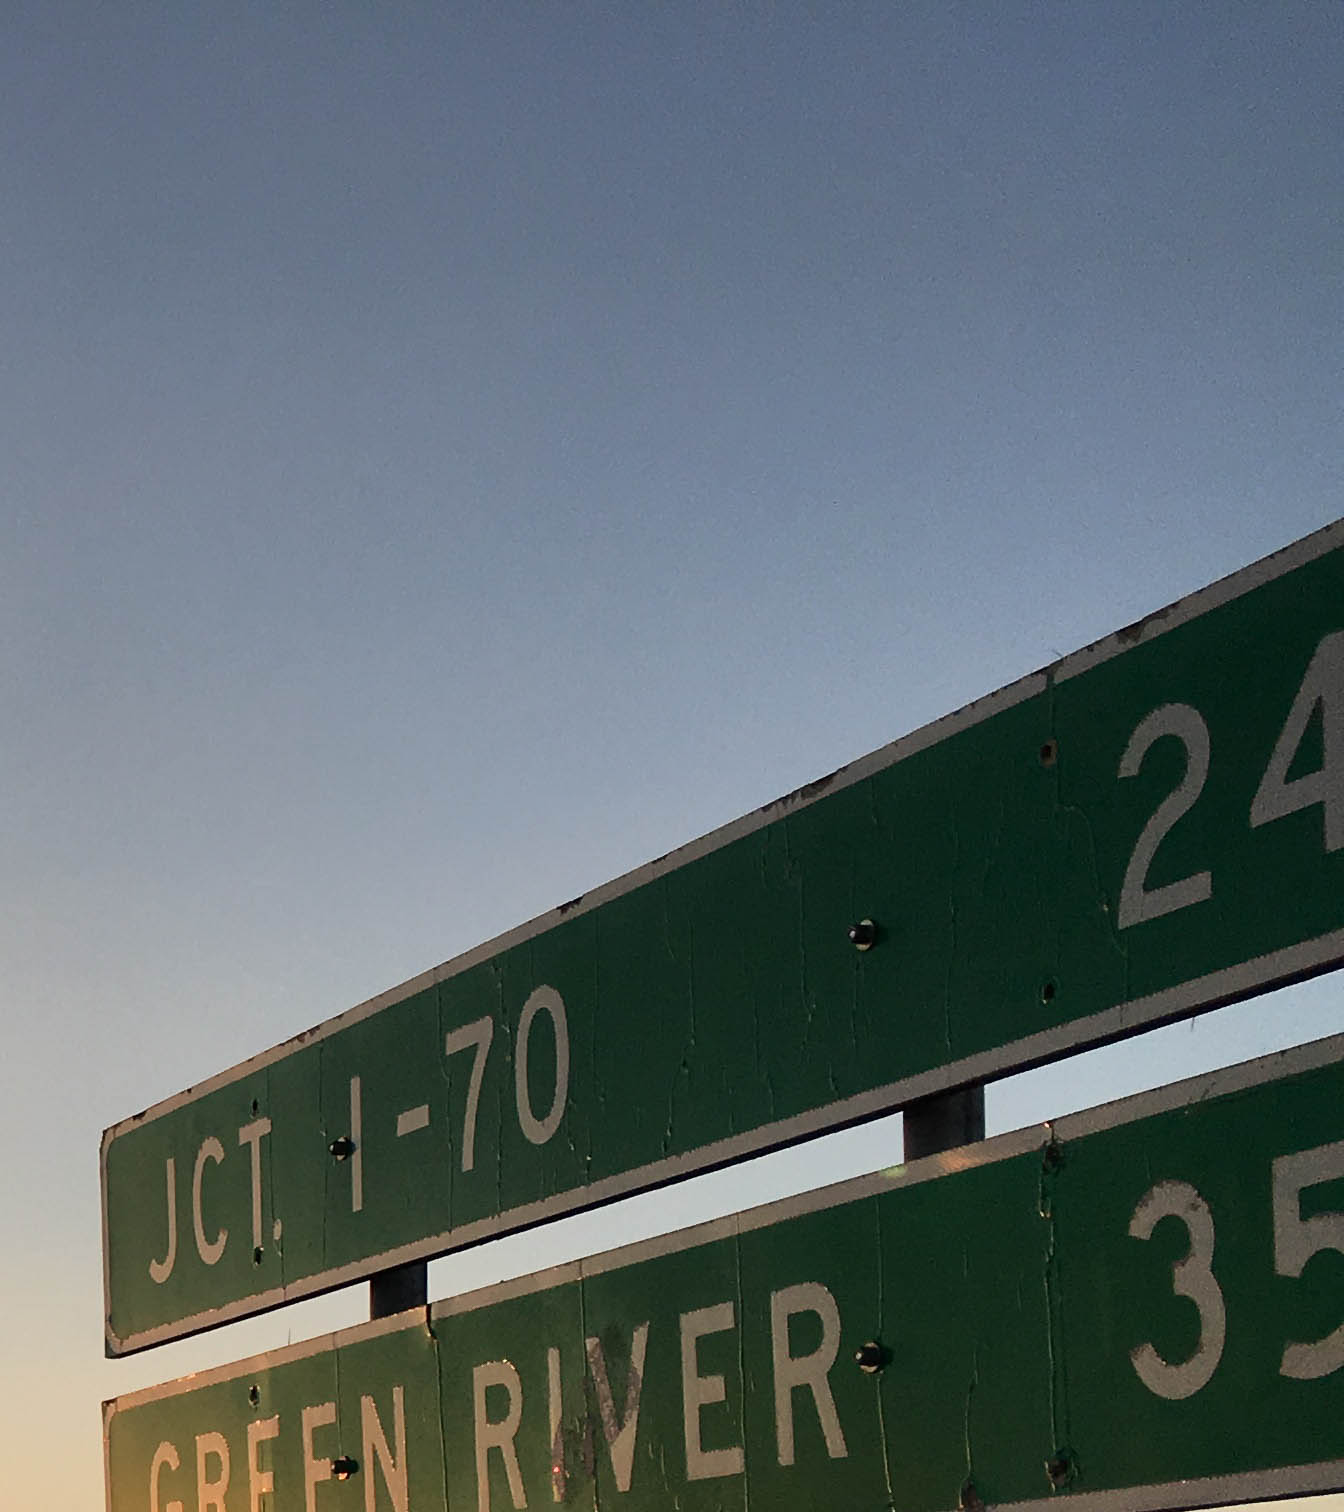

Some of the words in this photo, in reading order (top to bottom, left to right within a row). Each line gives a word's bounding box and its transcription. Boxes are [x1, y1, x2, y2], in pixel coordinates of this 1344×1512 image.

[349, 984, 571, 1213] I-70
[1117, 629, 1344, 929] 24
[1127, 1141, 1344, 1400] 35
